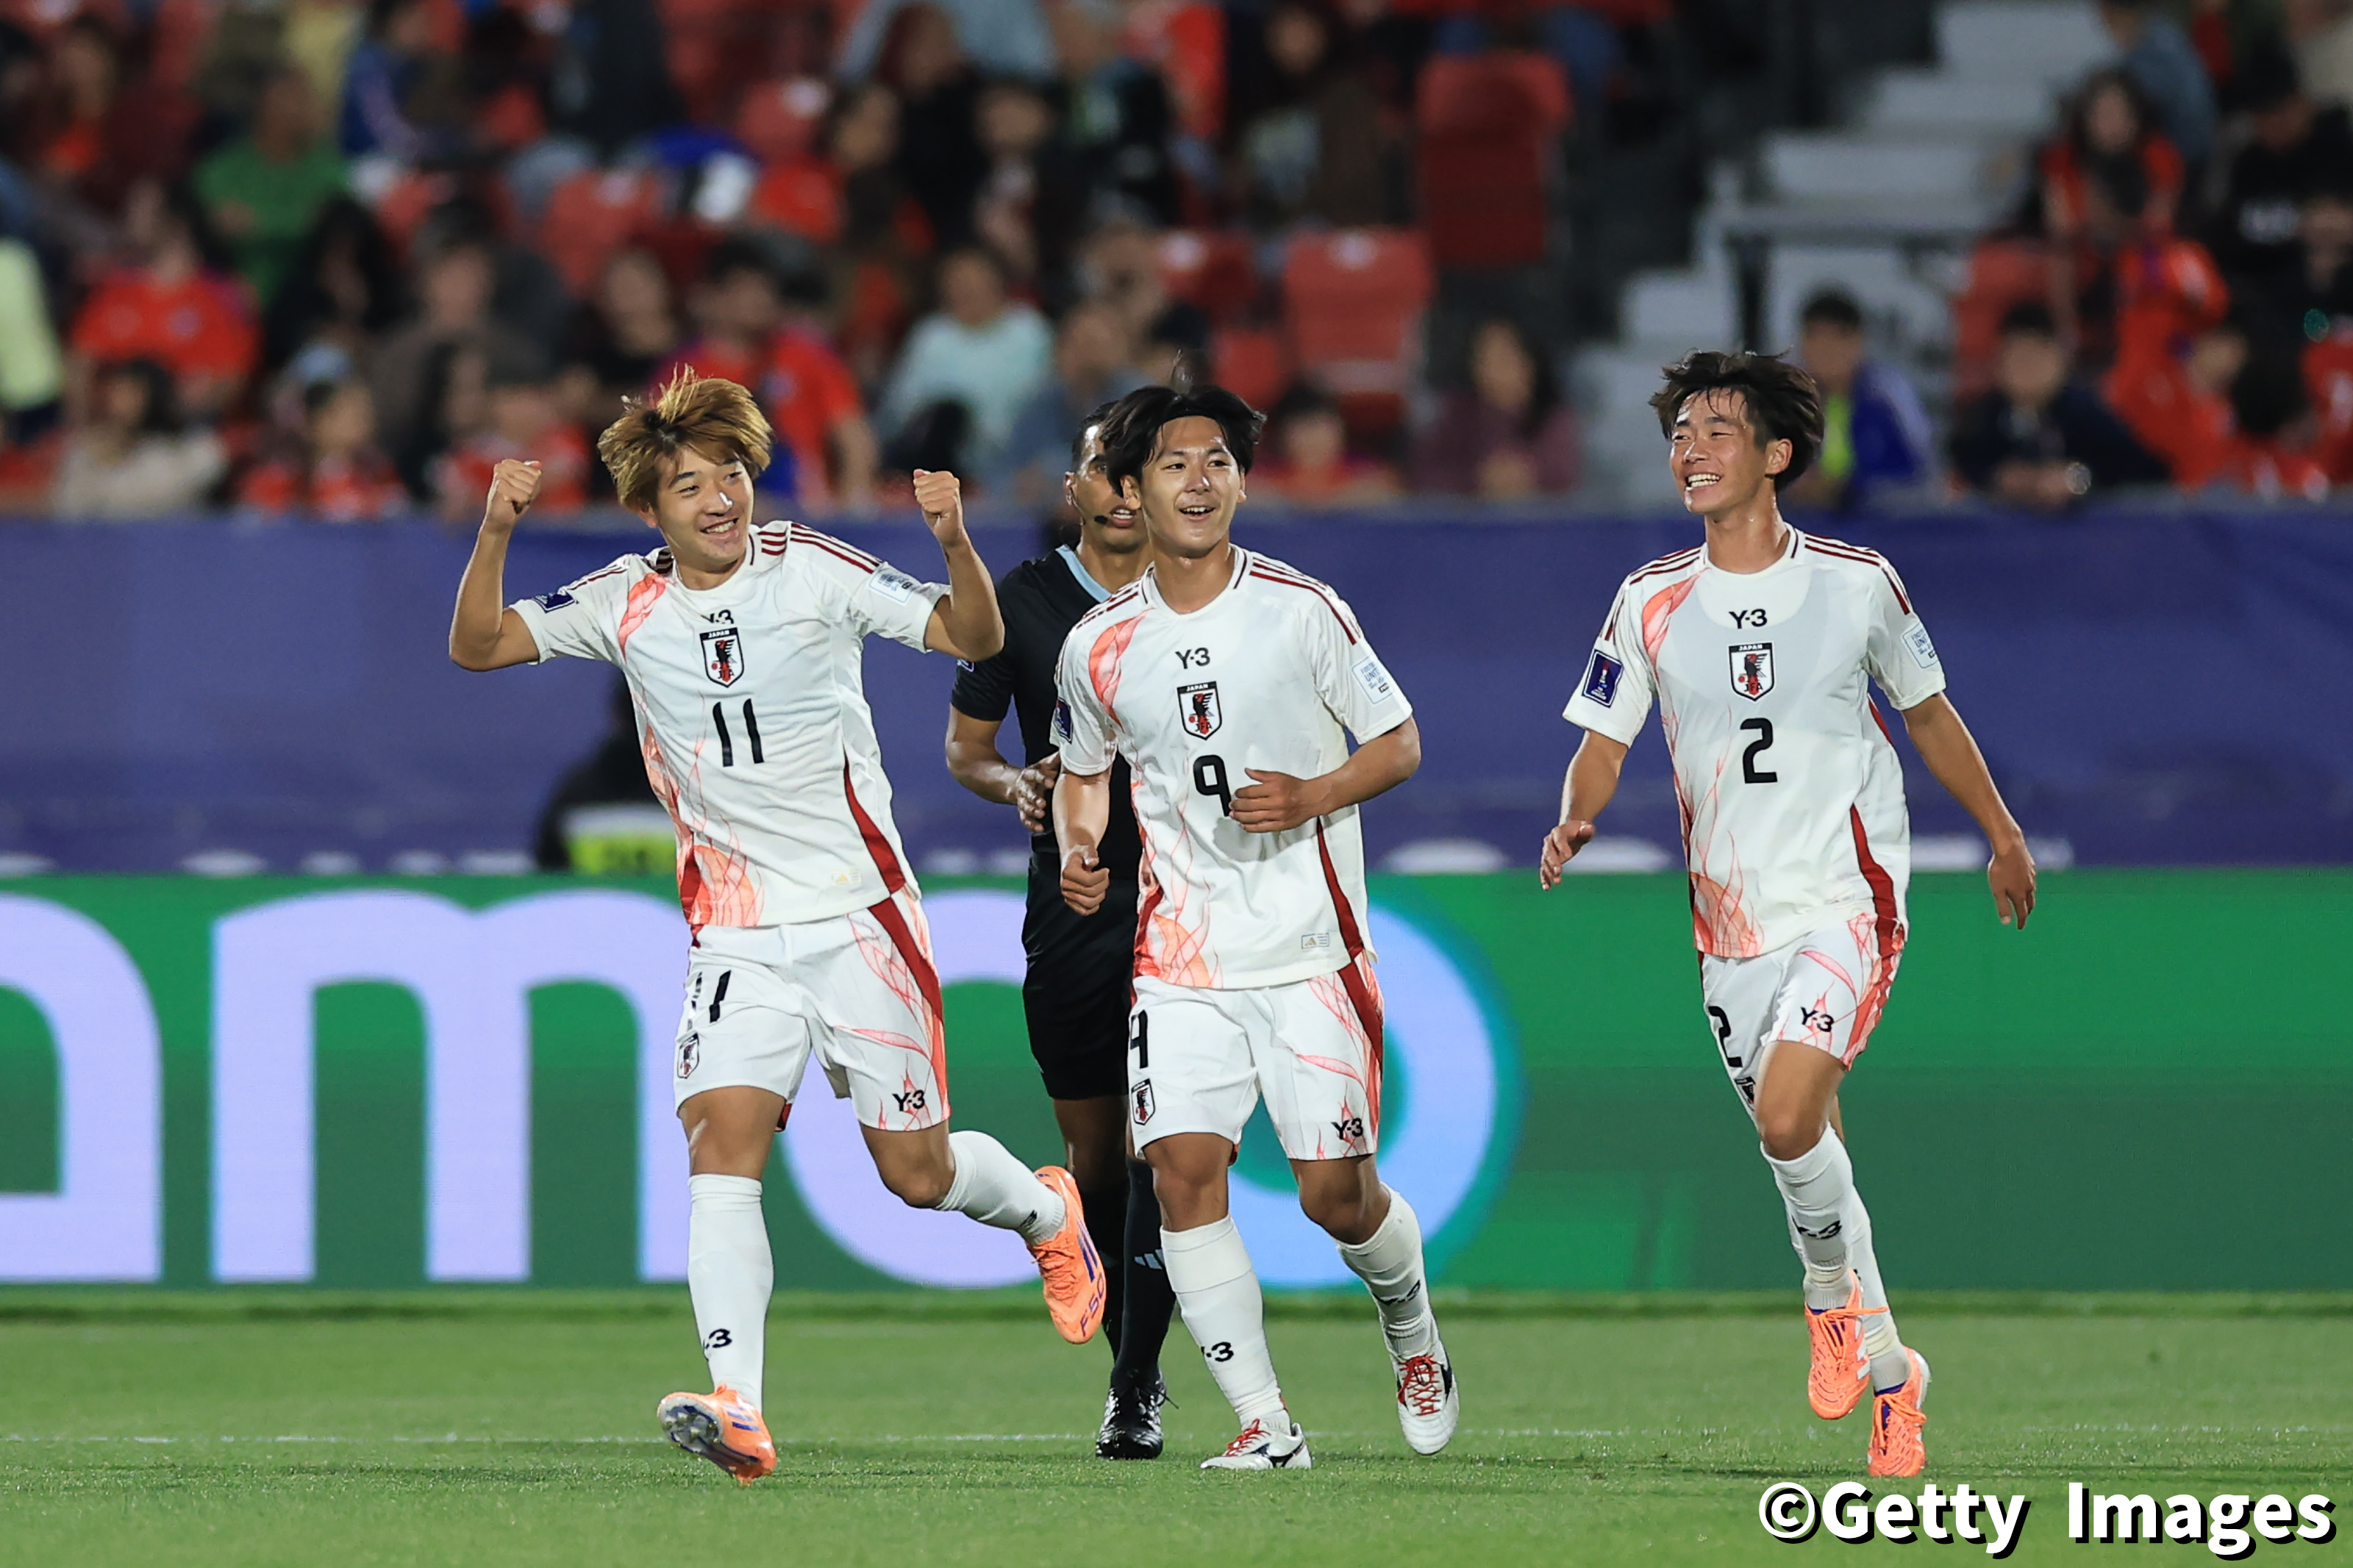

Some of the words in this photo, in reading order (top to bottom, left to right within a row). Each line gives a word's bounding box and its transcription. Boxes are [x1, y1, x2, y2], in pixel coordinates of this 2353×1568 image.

[1728, 608, 1768, 629] Y-3
[1174, 647, 1211, 670] Y-3
[1186, 683, 1209, 692] JAPAN
[712, 698, 764, 767] 11
[1740, 717, 1778, 784] 2
[1193, 754, 1232, 817] 9
[1800, 1006, 1835, 1032] Y-3
[1707, 1006, 1743, 1068] 2
[891, 1089, 925, 1111] Y-3
[1330, 1117, 1364, 1139] Y-3
